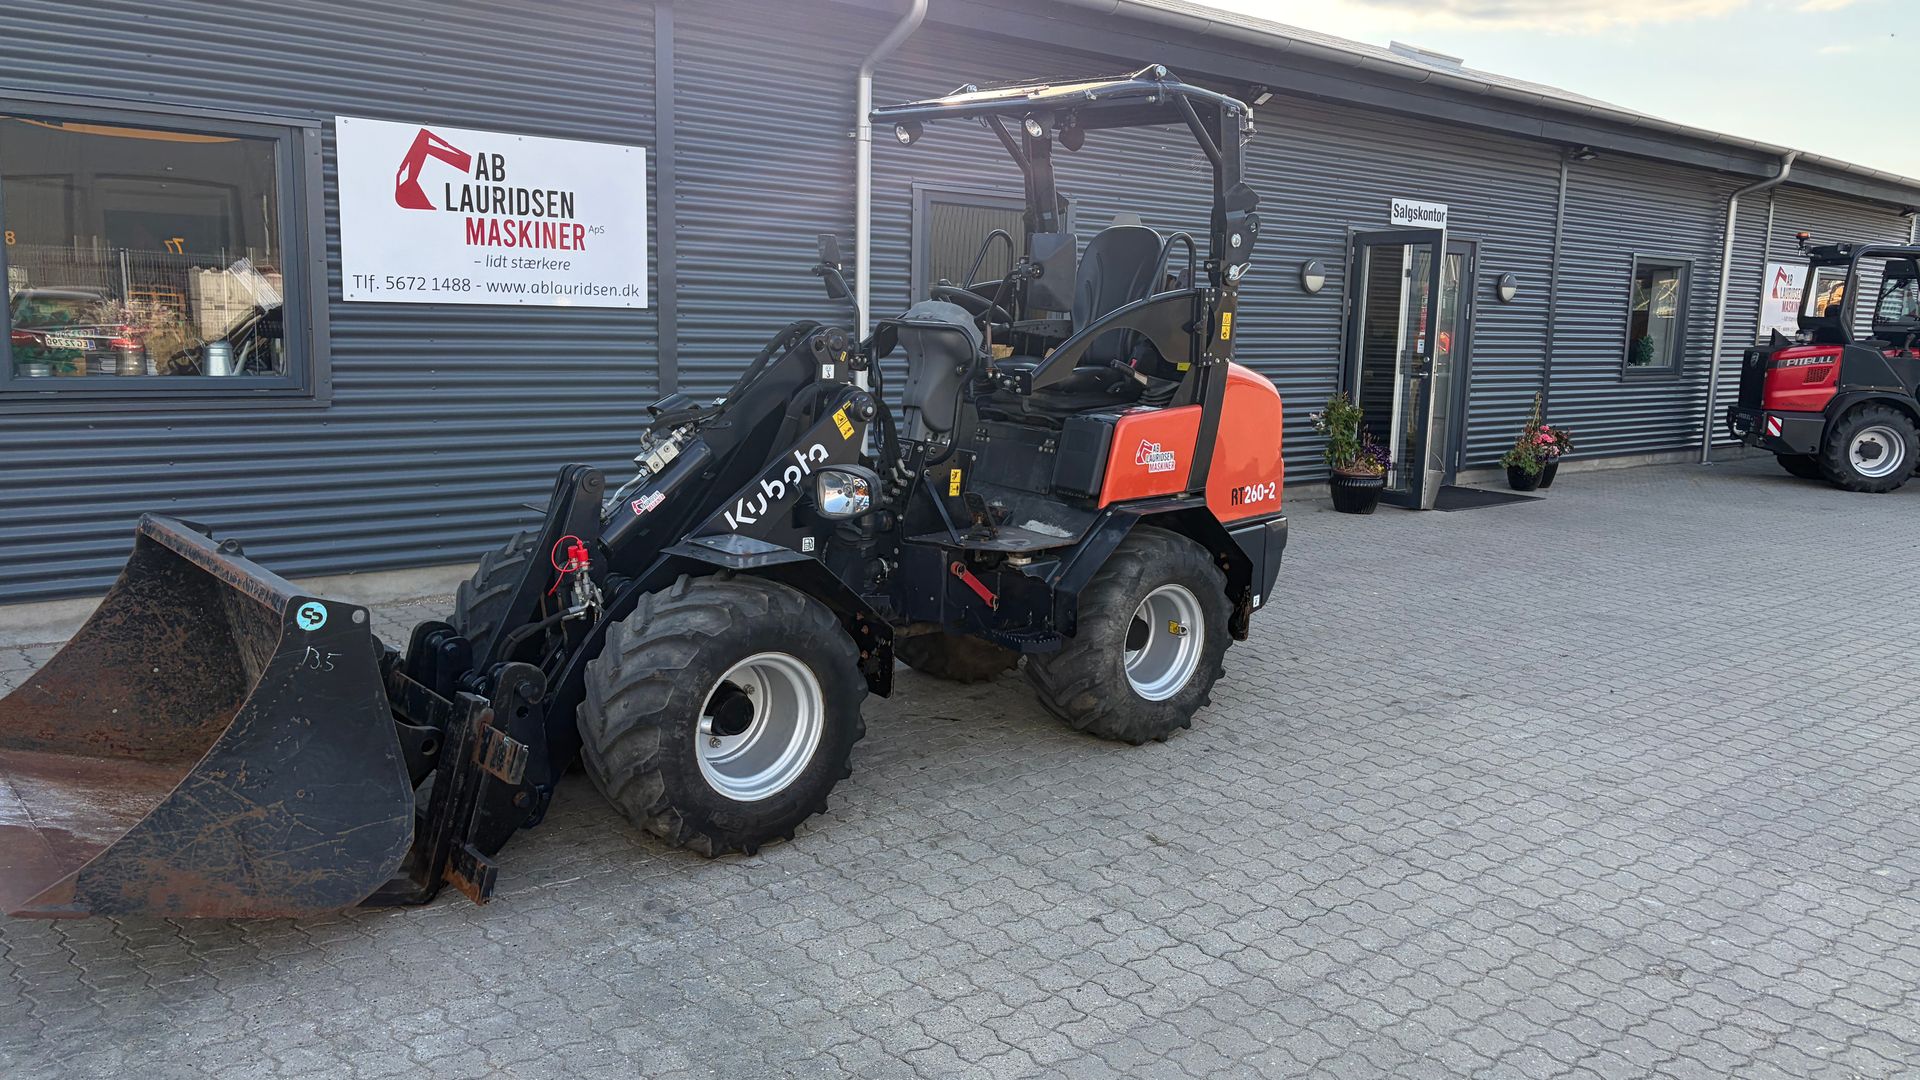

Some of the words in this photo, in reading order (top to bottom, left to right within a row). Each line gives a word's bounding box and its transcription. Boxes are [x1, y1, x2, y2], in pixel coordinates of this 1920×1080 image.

[475, 152, 506, 182] AB
[445, 182, 575, 219] LAURIDSEN
[1393, 203, 1446, 223] Salgskontor
[465, 217, 586, 251] MASKINER
[588, 224, 605, 235] ApS
[485, 254, 508, 269] lidt
[510, 257, 571, 271] stærkere
[352, 274, 380, 293] Tlf.
[385, 275, 427, 292] 5672
[431, 277, 471, 292] 1488
[486, 280, 640, 298] www.ablauridsen.dk
[1786, 355, 1834, 367] PITBULL
[724, 443, 829, 530] Kubota
[1231, 482, 1276, 506] RT260-2
